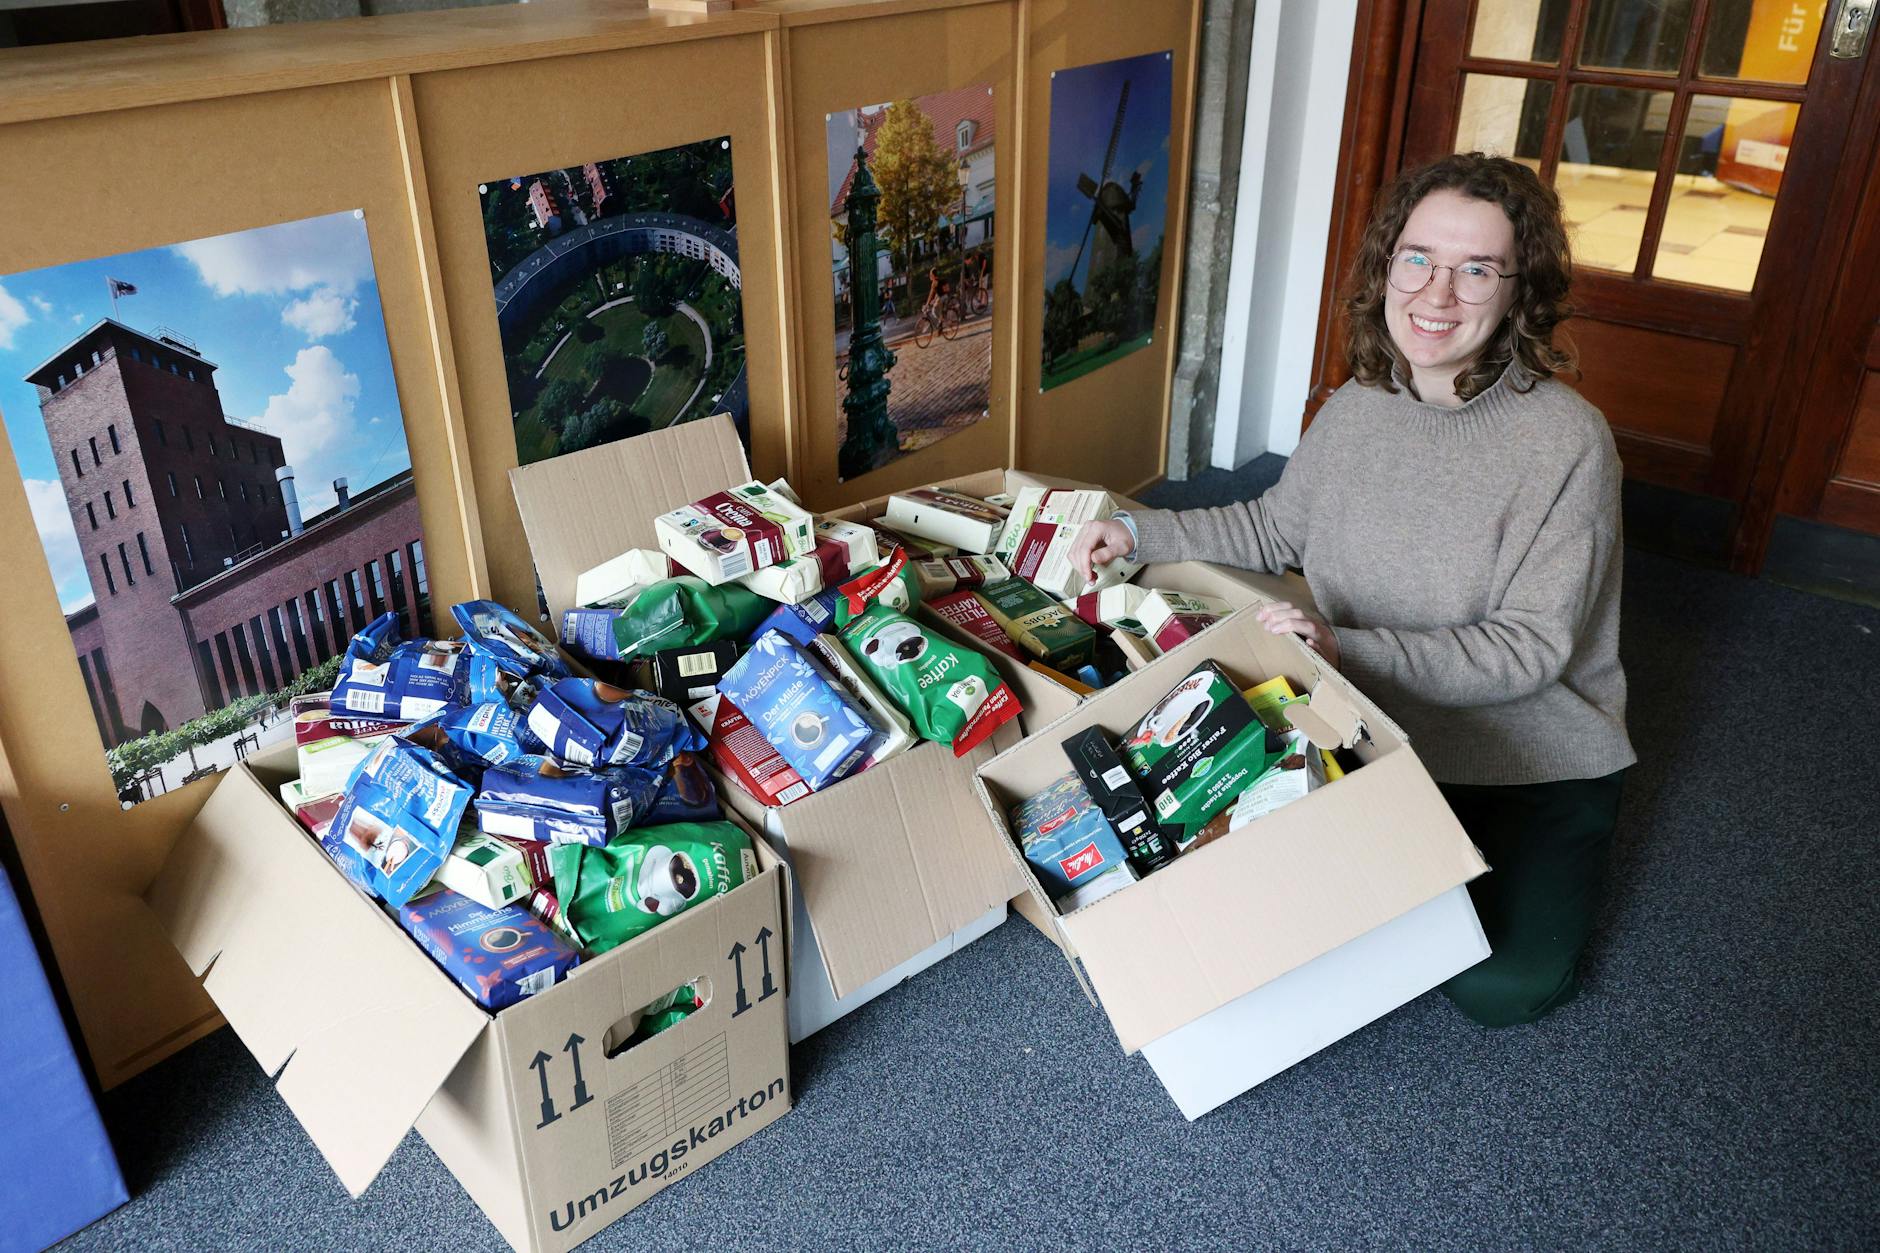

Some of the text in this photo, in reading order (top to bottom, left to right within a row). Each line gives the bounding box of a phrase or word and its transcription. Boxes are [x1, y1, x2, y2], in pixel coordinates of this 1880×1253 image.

[1778, 2, 1808, 52] Für
[714, 500, 752, 528] Crema
[1005, 523, 1022, 550] Bio
[873, 558, 902, 591] Partnerschaften
[938, 598, 980, 616] KAFFEE
[950, 607, 988, 625] FILTER
[1022, 605, 1064, 627] JACOBS
[739, 654, 789, 706] MÖVENPICK
[916, 652, 959, 690] Kaffee
[762, 703, 780, 722] Der
[777, 680, 803, 705] Milde
[990, 693, 1010, 711] Kaffee
[490, 711, 505, 735] HEISSE
[720, 714, 742, 727] KRÄFTIG
[957, 687, 1006, 742] fairen Partnerschaften
[497, 718, 511, 737] LIEBE
[1160, 724, 1226, 784] Fairer Bio Kaffee
[1220, 767, 1248, 793] Doppelte
[1199, 789, 1223, 812] Frische
[1066, 849, 1092, 869] Melitta
[702, 858, 714, 889] gemahlen
[429, 898, 474, 918] MÖVEN
[468, 911, 483, 919] Der
[550, 1077, 784, 1233] Umzugskarton
[664, 1162, 688, 1181] 14010
